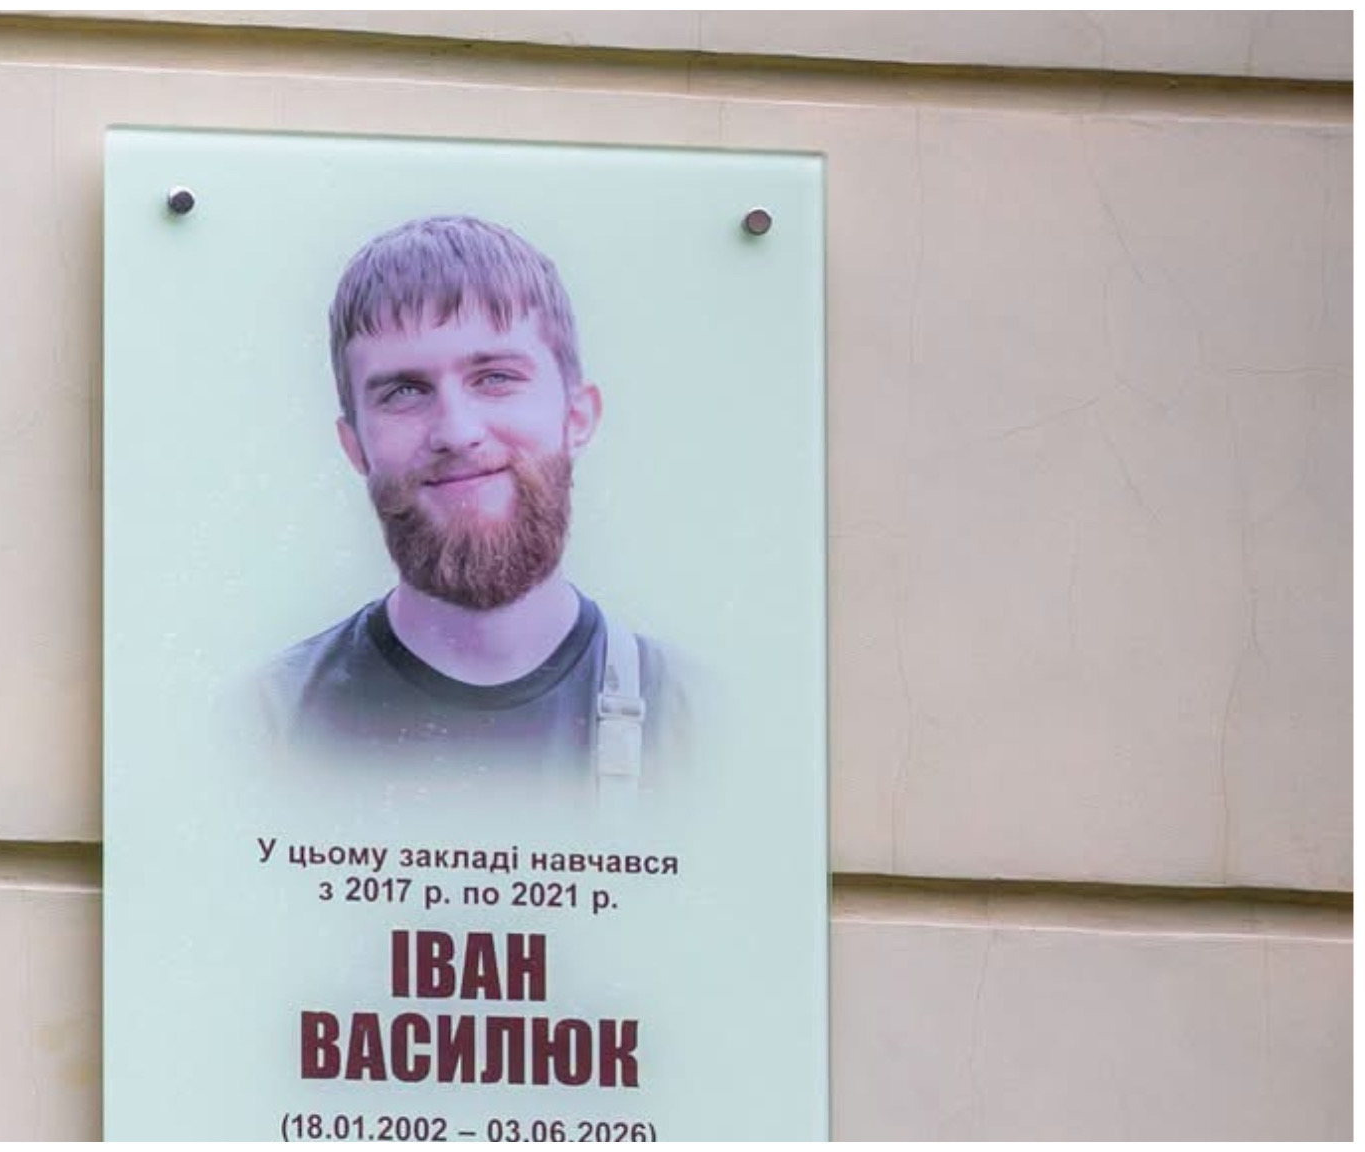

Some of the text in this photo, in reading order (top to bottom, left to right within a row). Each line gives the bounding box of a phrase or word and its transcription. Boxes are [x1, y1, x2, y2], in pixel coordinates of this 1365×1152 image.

[257, 837, 678, 875] У цьому закладі навчався
[318, 876, 618, 915] з 2017 р. по 2021 р.
[391, 929, 547, 1002] ІВАН
[300, 1010, 640, 1088] ВАСИЛЮК
[281, 1113, 448, 1142] (18.01.2002
